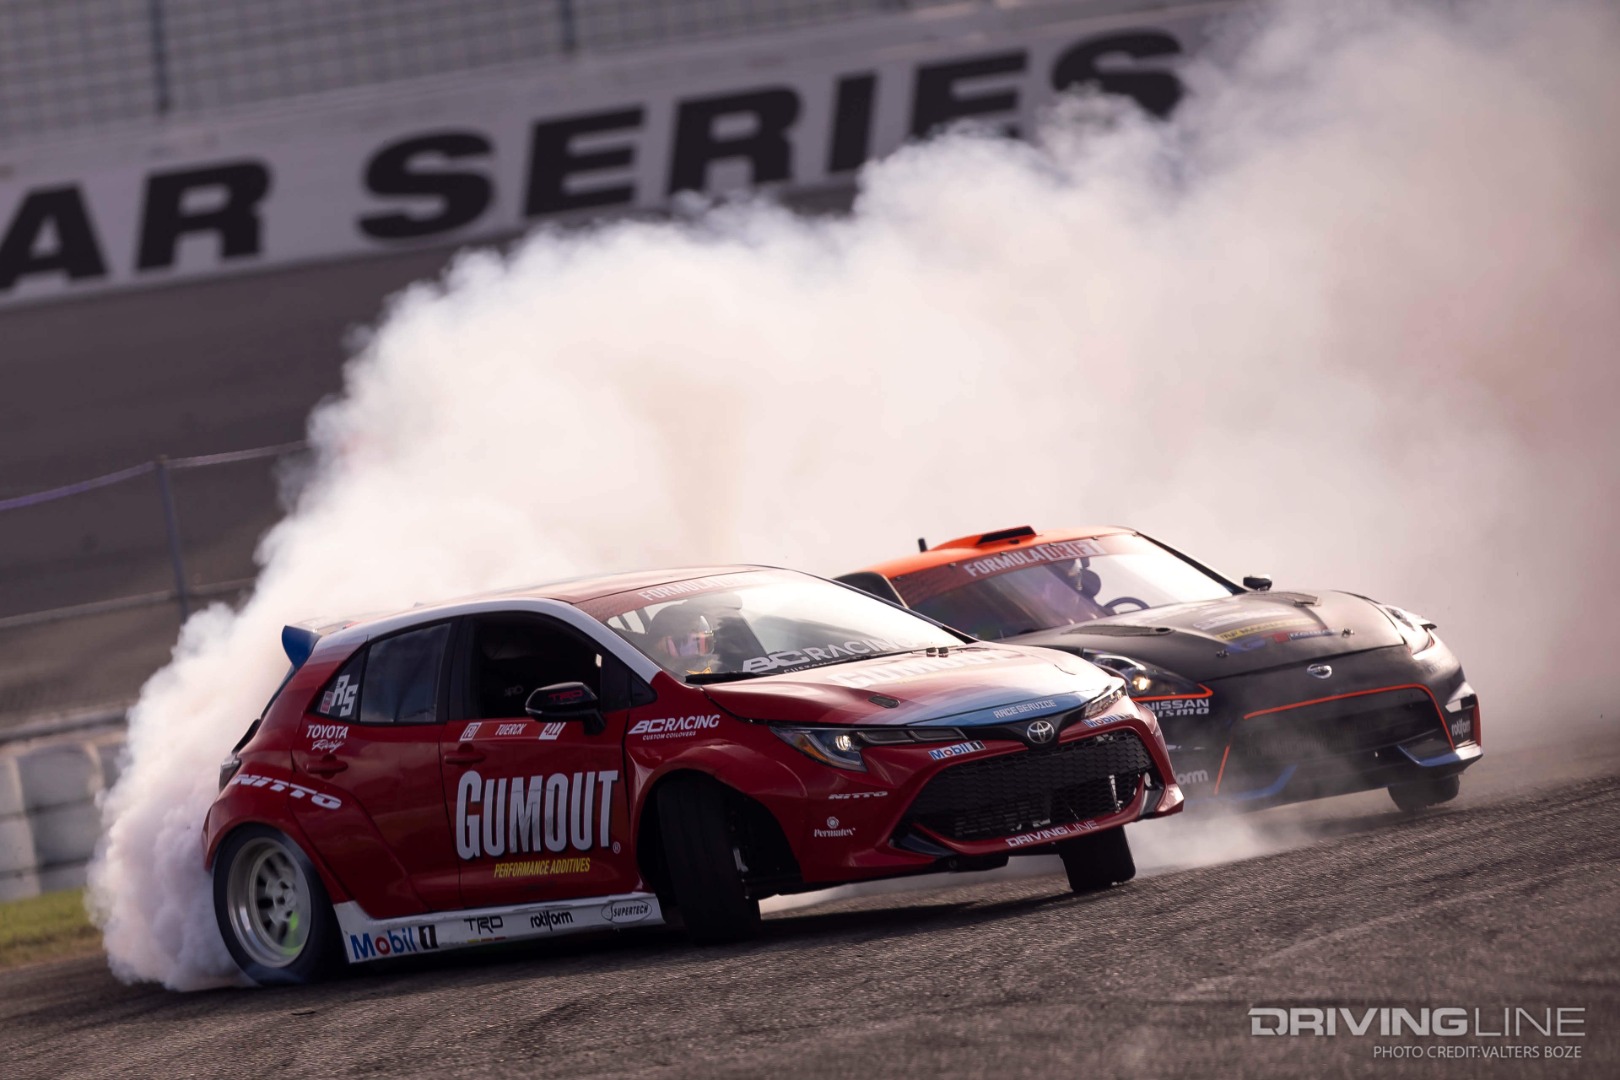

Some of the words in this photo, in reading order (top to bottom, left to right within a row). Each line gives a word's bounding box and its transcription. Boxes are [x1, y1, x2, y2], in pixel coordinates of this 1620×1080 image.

[354, 27, 1182, 240] SERIES
[963, 546, 1043, 577] FORMULA
[332, 674, 359, 718] RS
[1142, 699, 1209, 711] NISSAN
[1155, 707, 1209, 717] ismo
[495, 723, 528, 736] TUERCK
[1083, 715, 1118, 728] Mobil
[306, 725, 349, 739] TOYOTA
[642, 733, 666, 741] CUSTOM
[666, 731, 697, 739] COILOVERS
[929, 742, 971, 760] Mobil
[231, 774, 342, 810] NITTO
[828, 790, 888, 800] NITTO
[457, 770, 618, 860] GUMOUT
[814, 827, 853, 838] Permatex
[494, 859, 550, 879] PERFORMANCE
[550, 857, 591, 875] ADDITIVES
[613, 903, 649, 918] SUPERTECH
[463, 915, 504, 935] TRD
[530, 911, 574, 932] rotiform
[350, 927, 418, 961] Mobil
[420, 925, 436, 950] 1
